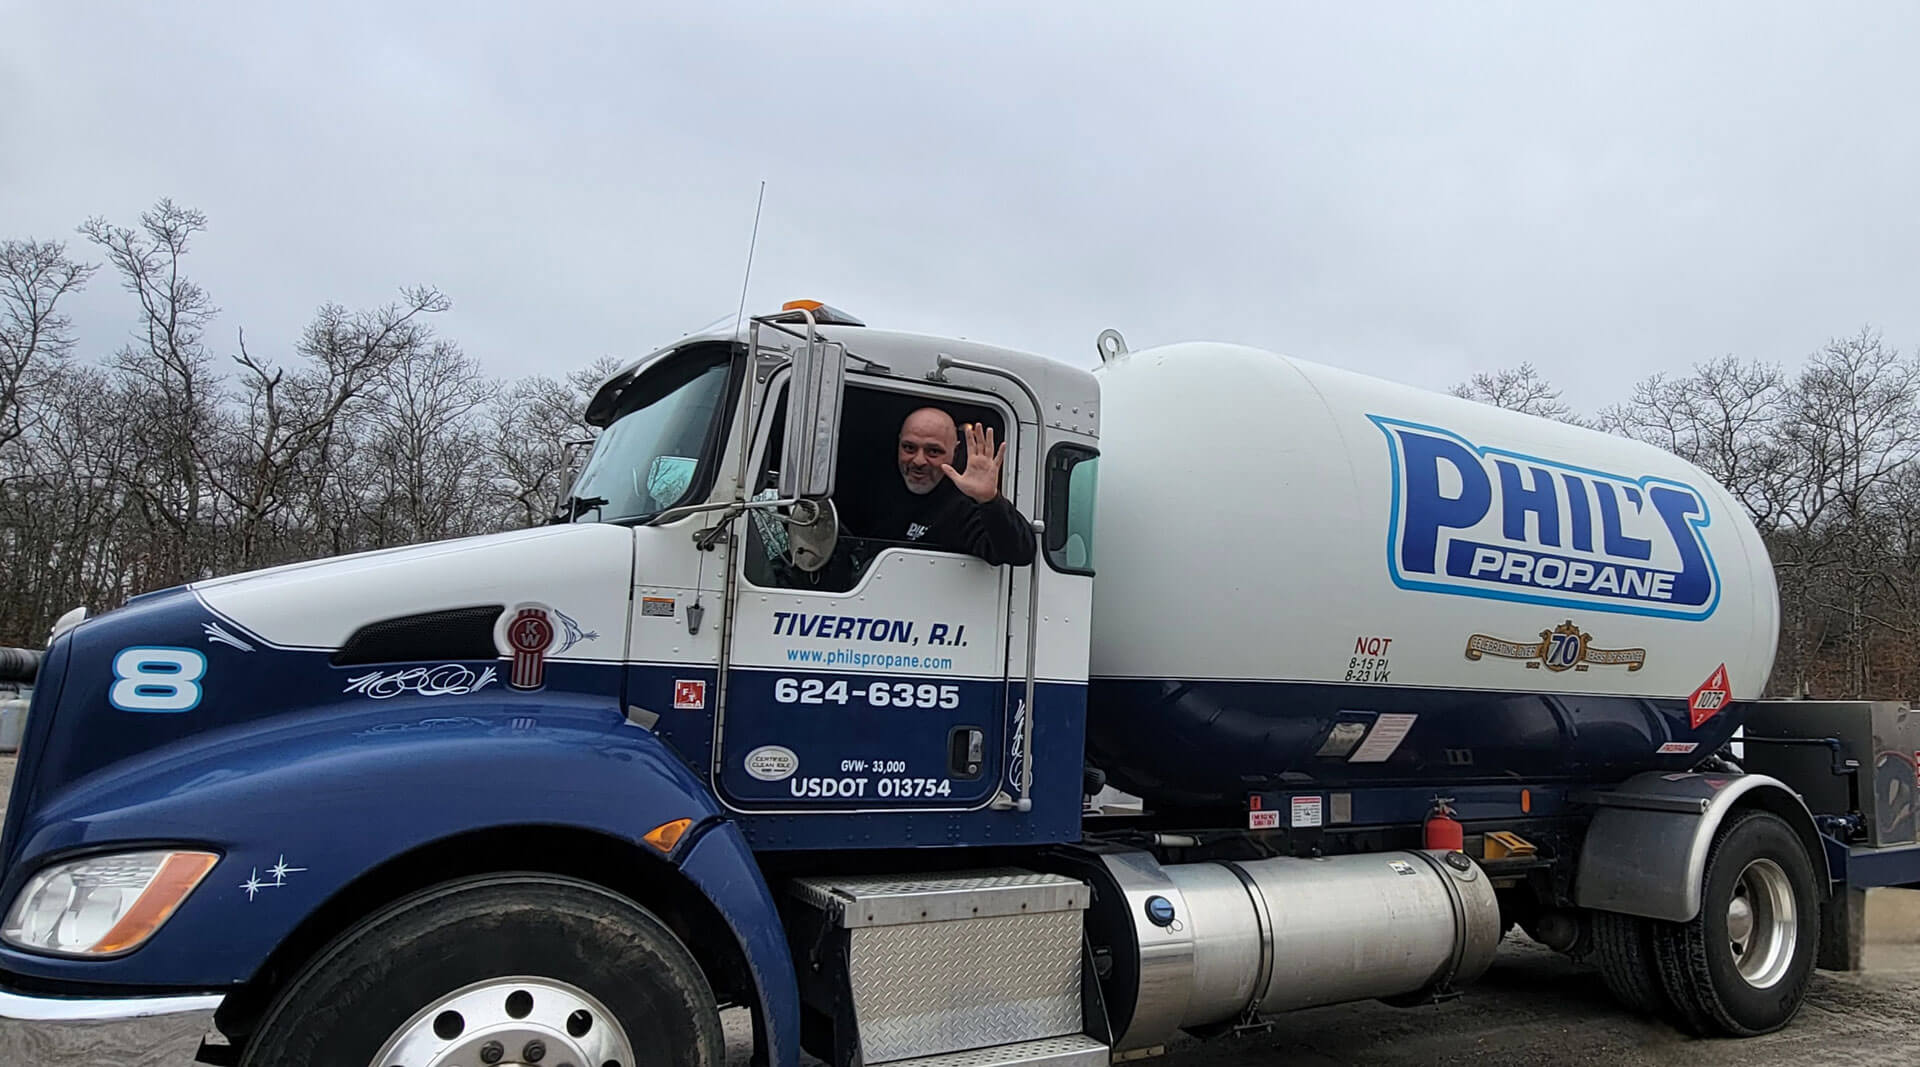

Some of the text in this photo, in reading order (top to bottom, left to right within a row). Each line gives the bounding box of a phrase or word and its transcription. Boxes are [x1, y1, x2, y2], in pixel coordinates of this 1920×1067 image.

[1396, 429, 1712, 606] PHIL'S
[1470, 547, 1676, 600] PROPANE
[525, 621, 539, 635] K
[773, 611, 968, 647] TIVERTON, R.I.
[1354, 636, 1393, 656] NQT
[1549, 634, 1580, 665] 70
[787, 648, 952, 670] www.philspropane.com
[1349, 657, 1374, 670] 8-15
[109, 646, 207, 712] 8
[1345, 669, 1391, 682] 8-23 VK
[774, 678, 960, 709] 624-6395
[1697, 692, 1724, 708] 1075
[841, 760, 906, 774] GVW- 33,000
[790, 778, 952, 797] USDOT 013754
